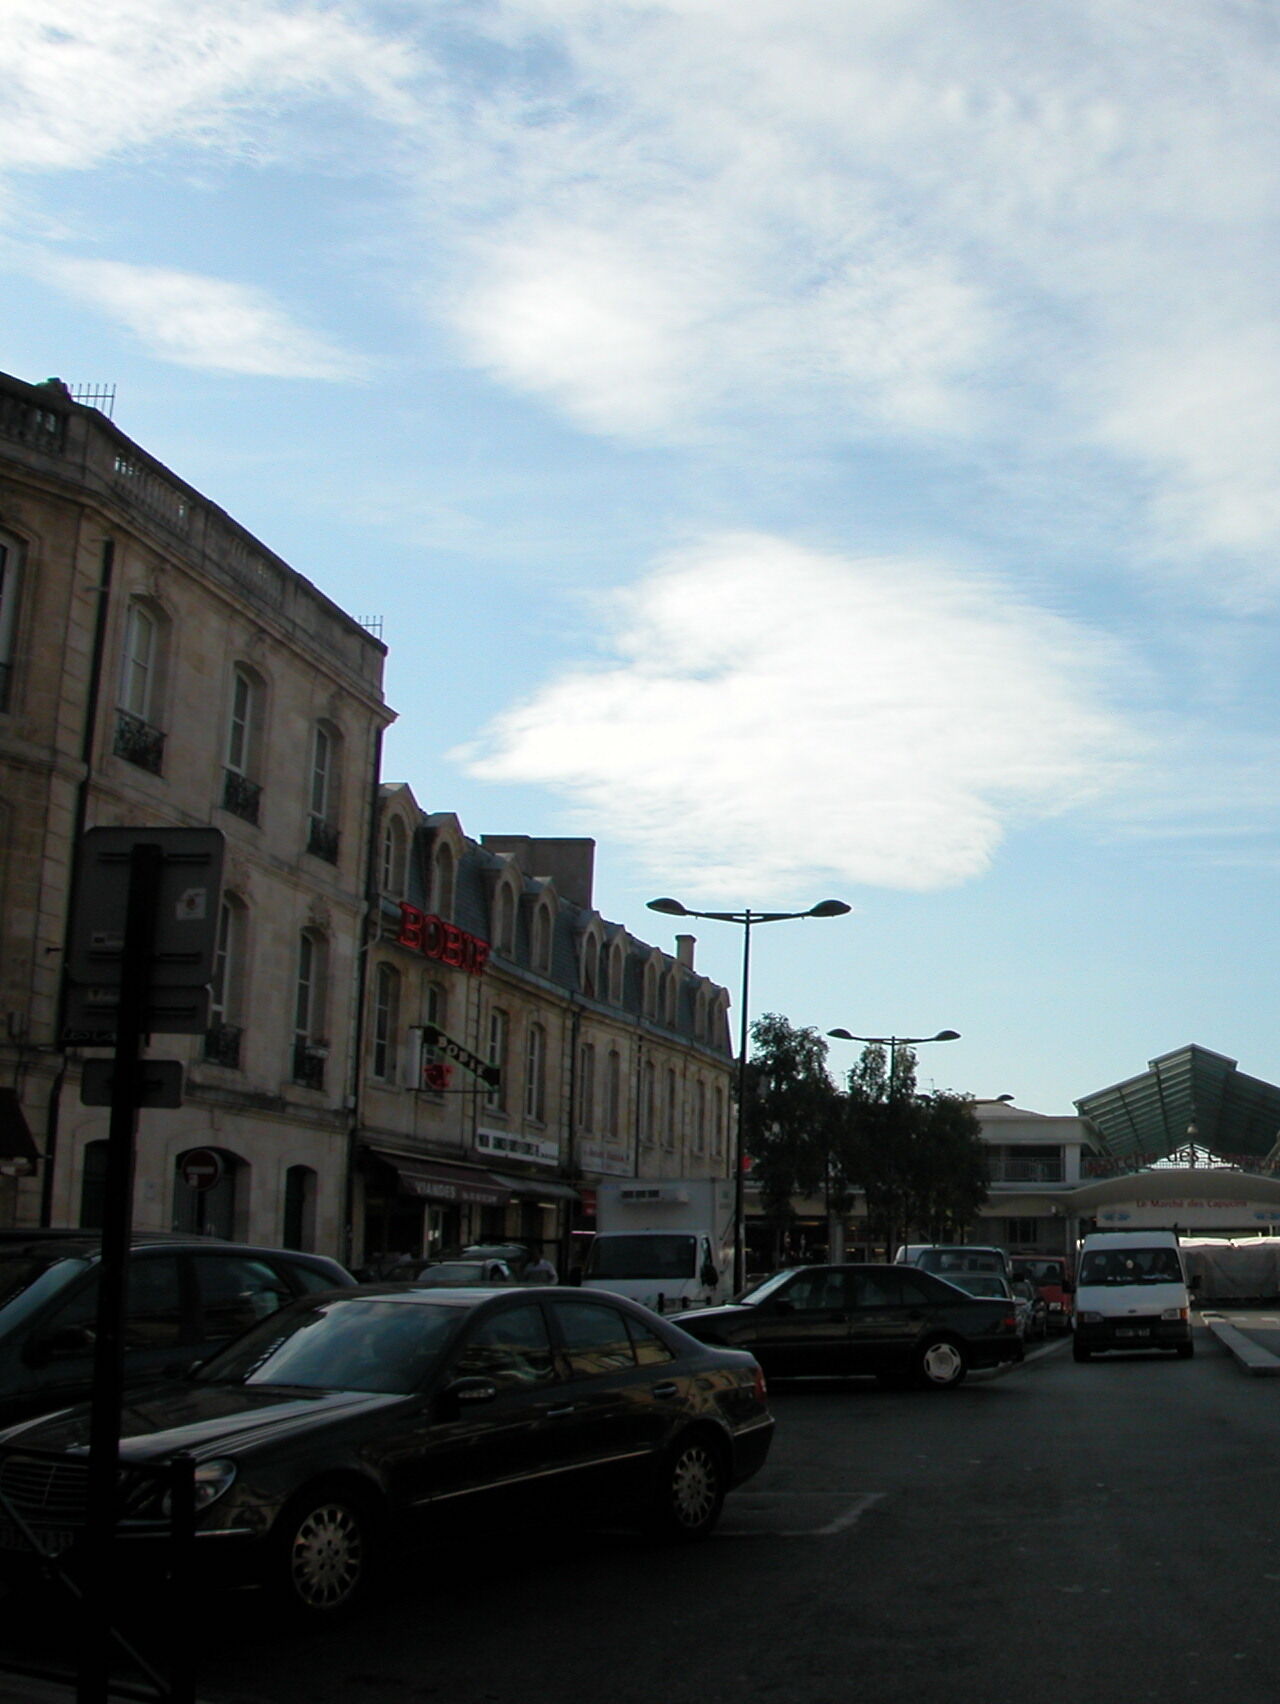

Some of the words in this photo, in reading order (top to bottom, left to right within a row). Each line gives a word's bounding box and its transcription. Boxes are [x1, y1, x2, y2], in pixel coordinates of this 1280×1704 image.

[1167, 1146, 1199, 1163] des
[1136, 1200, 1147, 1208] Le
[1188, 1199, 1204, 1208] des
